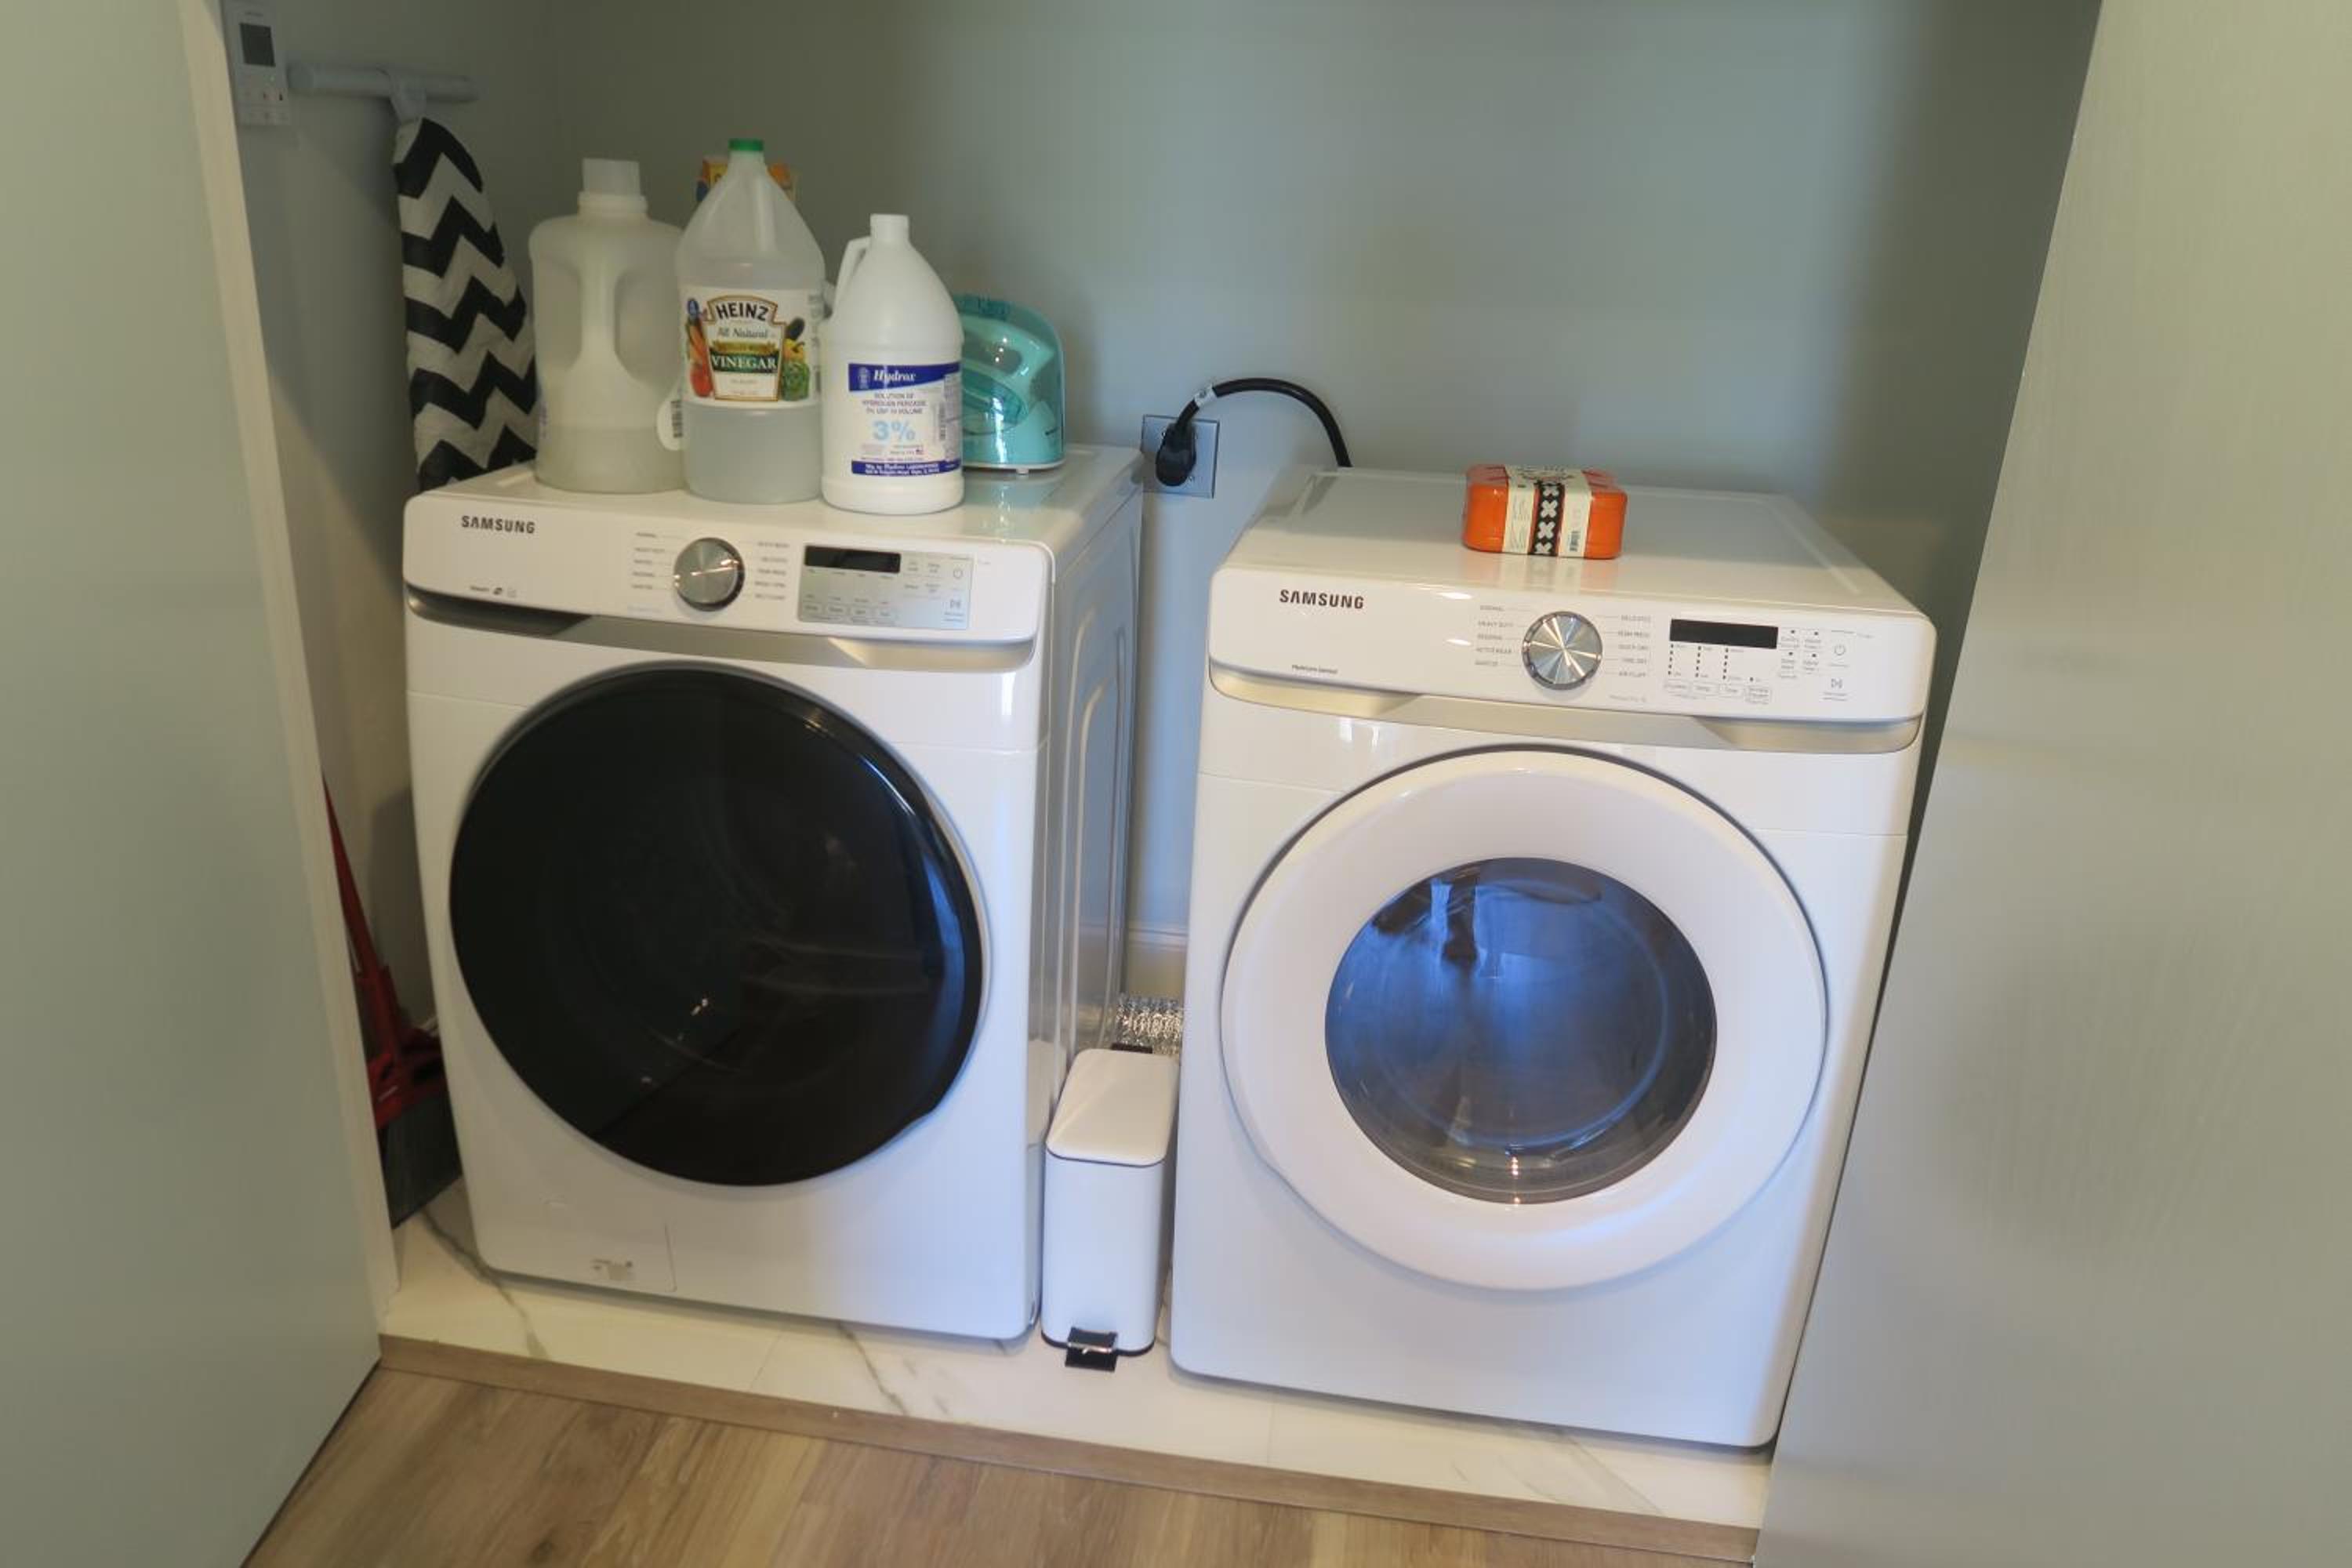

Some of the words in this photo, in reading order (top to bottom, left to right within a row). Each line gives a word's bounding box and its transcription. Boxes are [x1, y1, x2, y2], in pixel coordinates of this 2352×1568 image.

[716, 302, 769, 321] HEINZ
[732, 327, 768, 339] Natural
[710, 354, 777, 370] VINEGAR
[873, 369, 916, 384] Hydrox
[873, 420, 916, 441] 3%
[461, 515, 535, 534] SAMSUNG
[1279, 589, 1364, 609] SAMSUNG
